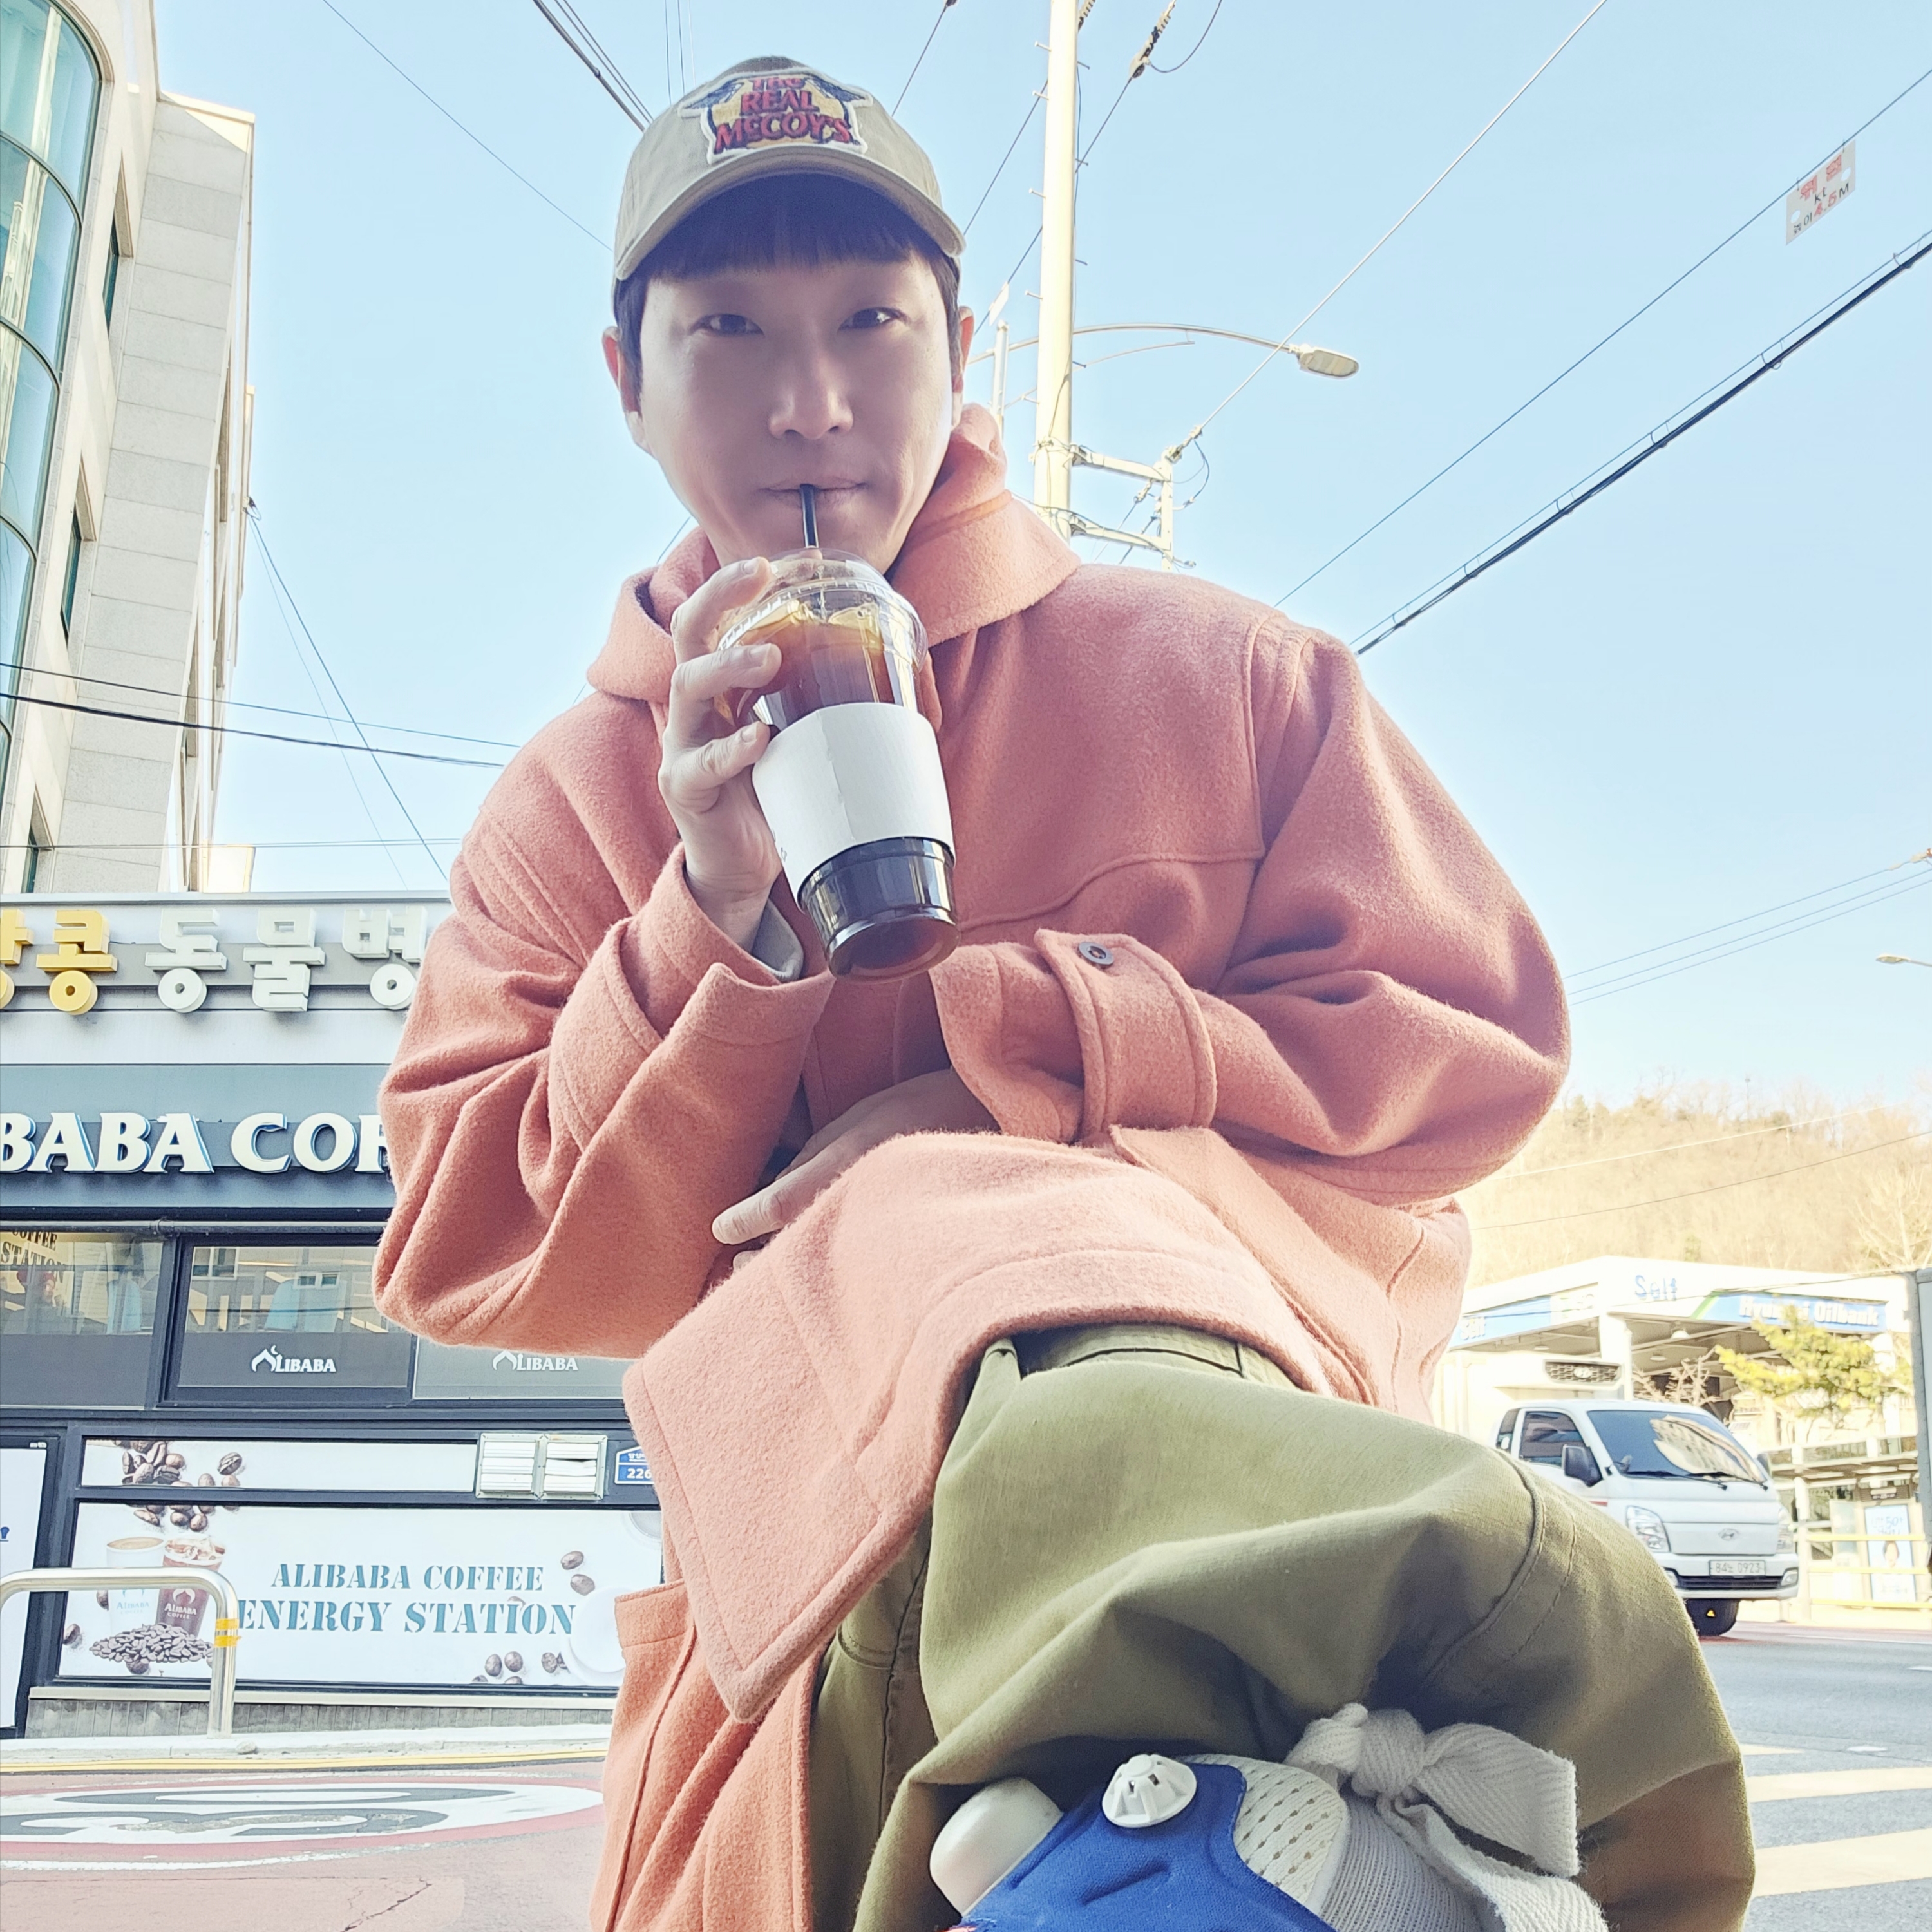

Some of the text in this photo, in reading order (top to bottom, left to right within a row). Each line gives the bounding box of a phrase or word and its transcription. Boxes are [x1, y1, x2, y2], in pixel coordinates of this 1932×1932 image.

[740, 90, 820, 116] REAL
[0, 1112, 214, 1173] BABA
[1634, 1274, 1678, 1301] Self
[1814, 1301, 1879, 1326] Oilbank
[270, 1563, 544, 1591] ALIBABA COFFEE
[1737, 1562, 1761, 1573] 0923
[238, 1600, 577, 1634] ENERGY STATION
